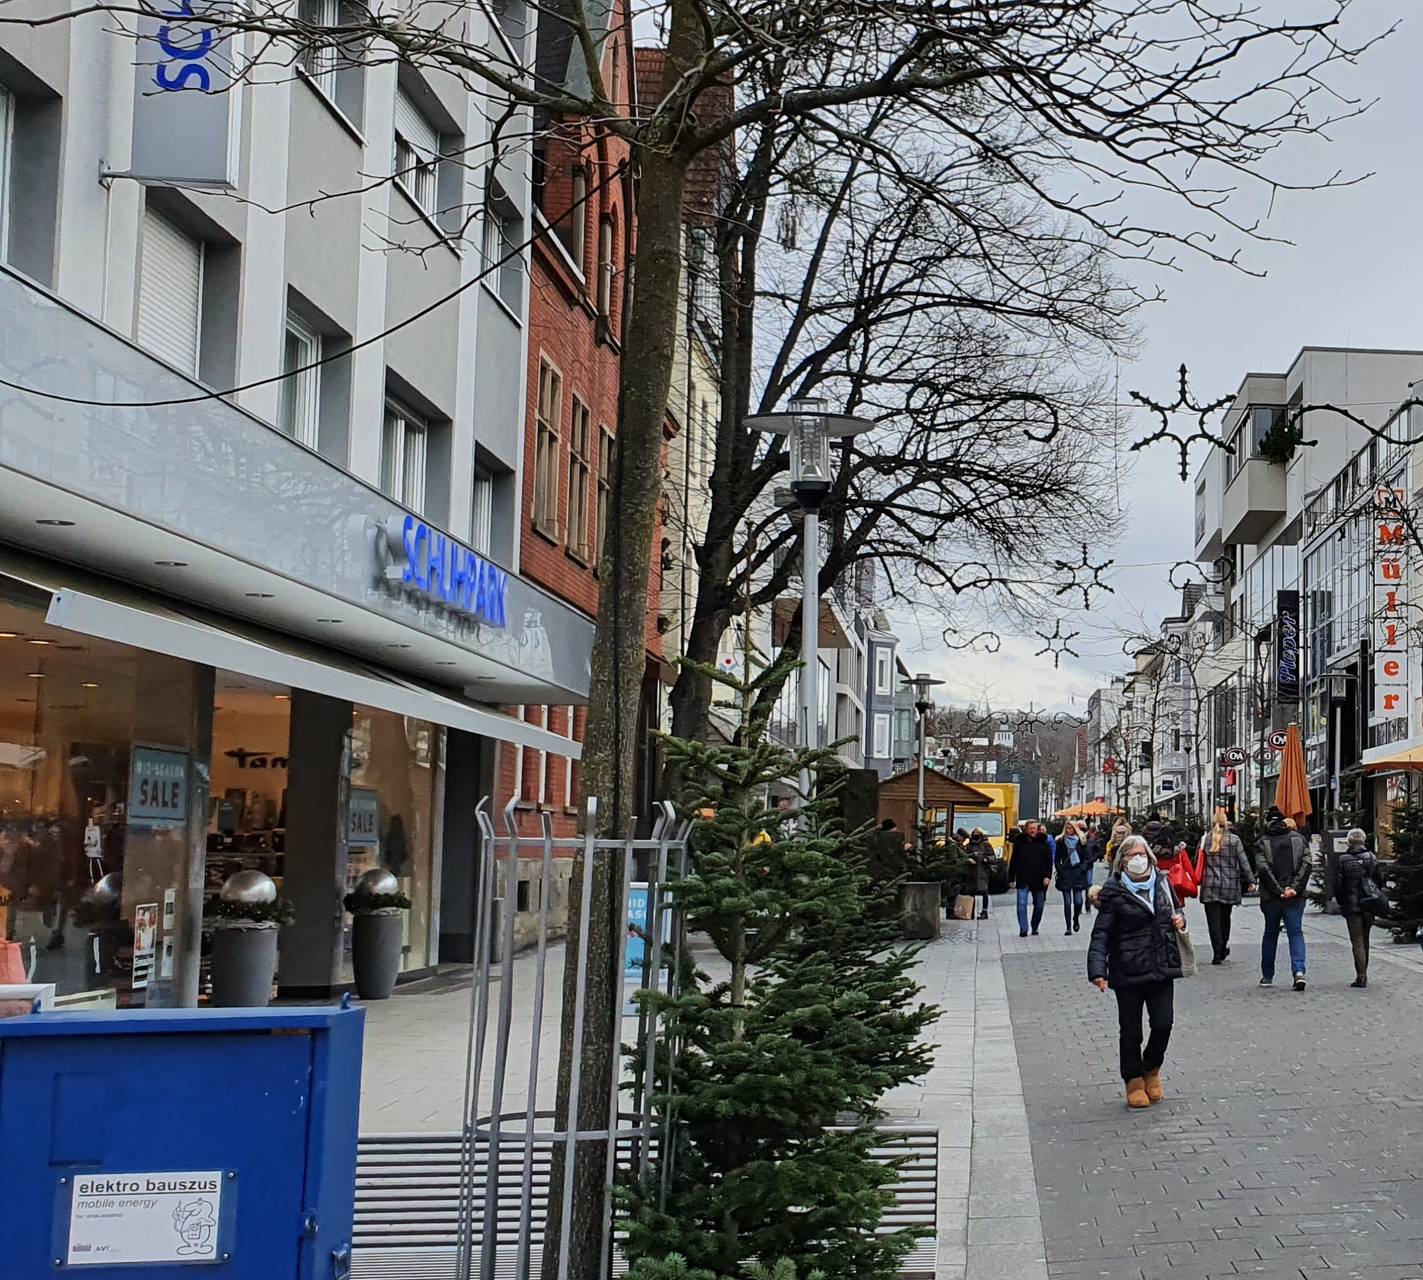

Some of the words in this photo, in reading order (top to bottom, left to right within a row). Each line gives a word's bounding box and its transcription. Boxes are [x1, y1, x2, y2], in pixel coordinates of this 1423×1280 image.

[402, 515, 508, 630] SCHUHPARK
[1378, 524, 1405, 711] Müller
[1279, 610, 1299, 684] Pieper
[140, 779, 181, 810] SALE
[351, 812, 374, 834] SALE
[79, 1180, 140, 1194] elektro
[145, 1178, 218, 1192] bauszus
[77, 1198, 115, 1209] mobile
[118, 1198, 158, 1209] energy
